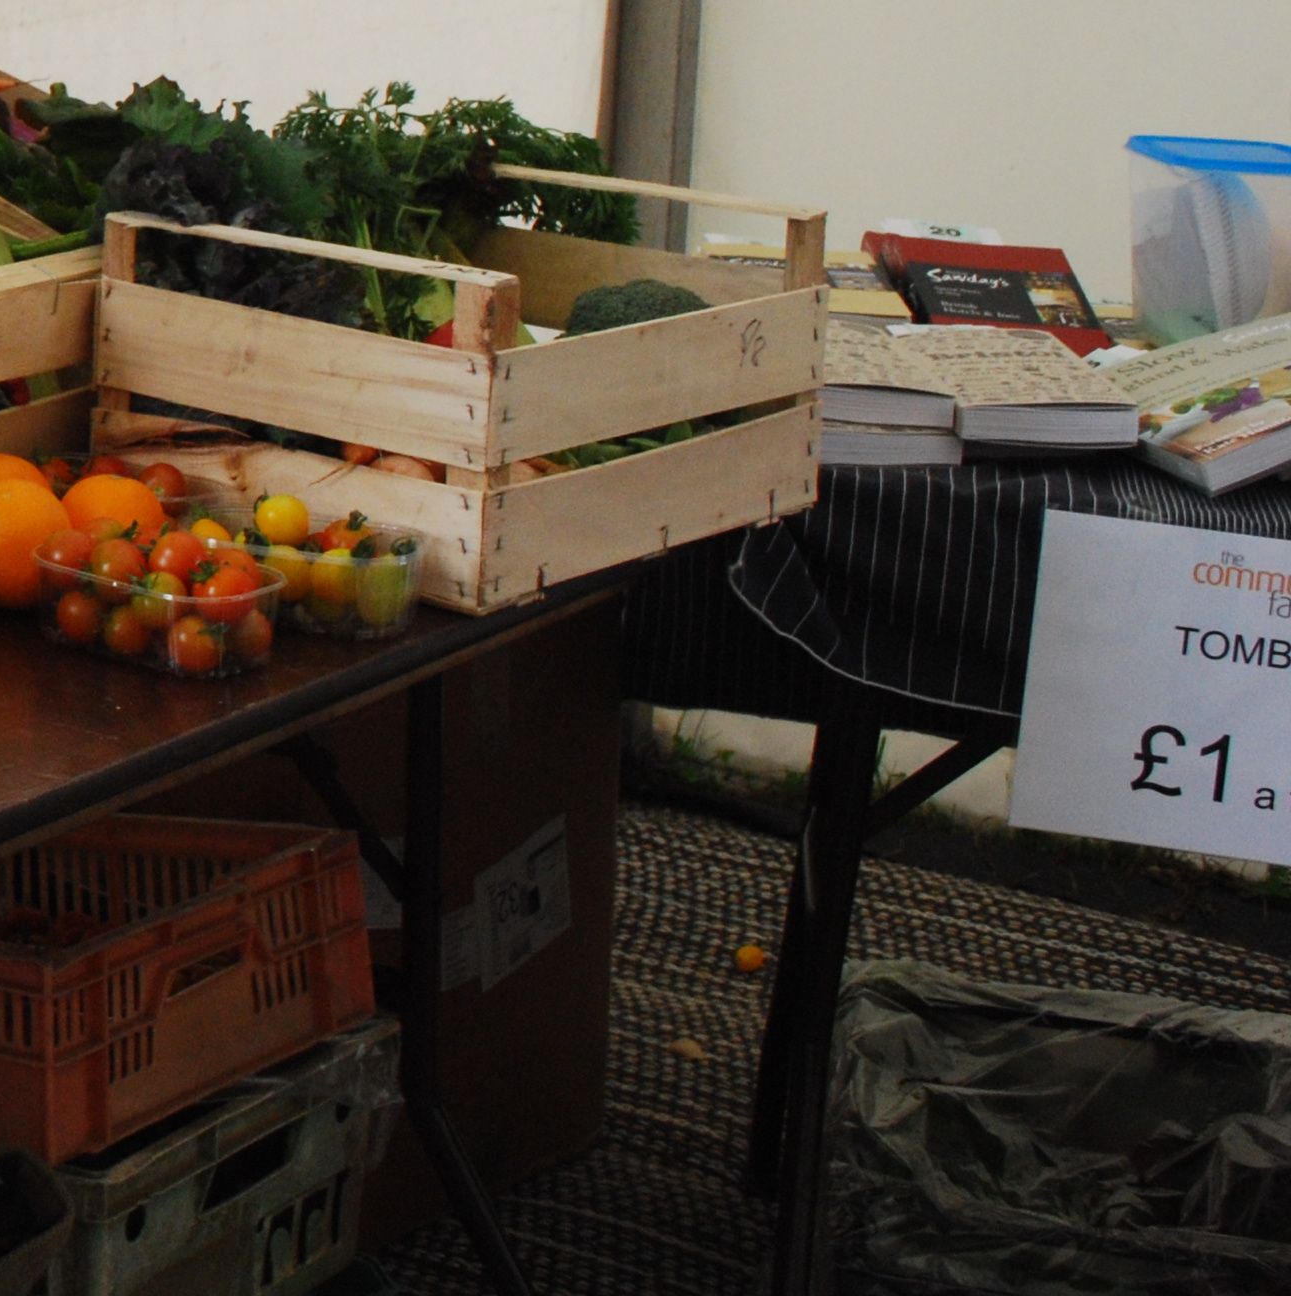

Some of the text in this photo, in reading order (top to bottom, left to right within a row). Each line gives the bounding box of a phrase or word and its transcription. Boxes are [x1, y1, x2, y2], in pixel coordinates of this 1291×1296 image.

[929, 225, 962, 238] 20
[926, 267, 1010, 289] Sawday's
[1221, 550, 1245, 567] the
[1174, 625, 1291, 670] TOMB
[1130, 724, 1276, 811] £1 a
